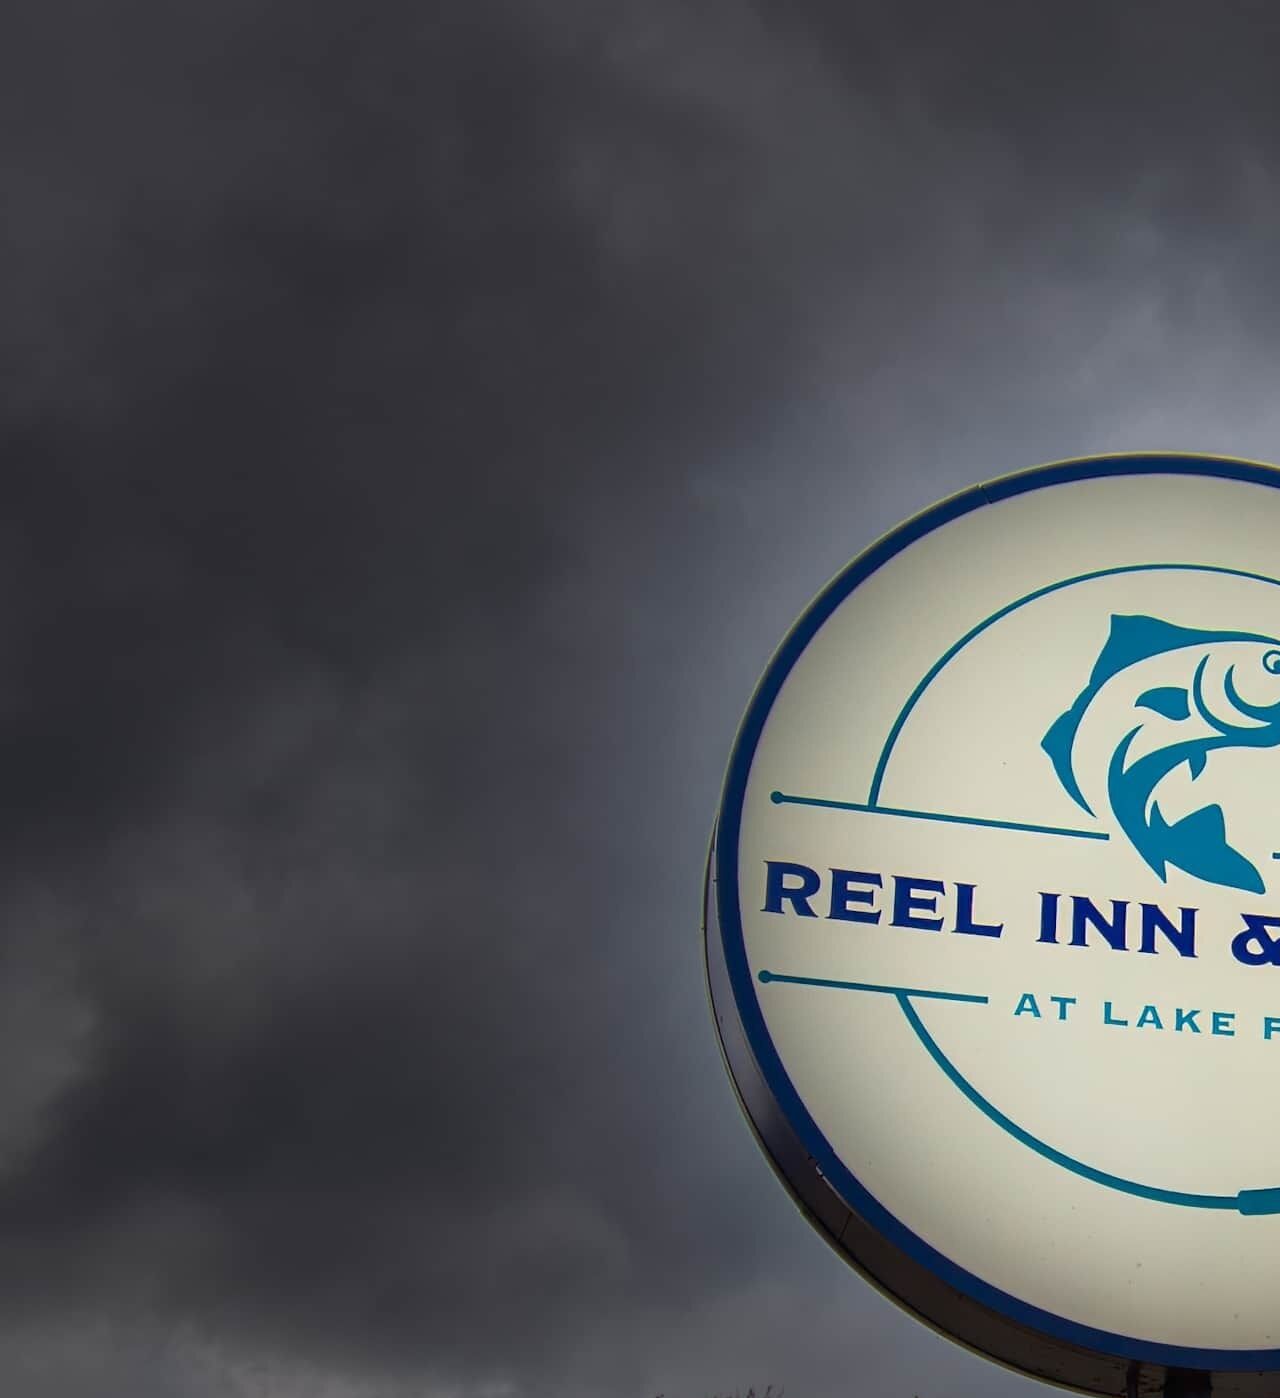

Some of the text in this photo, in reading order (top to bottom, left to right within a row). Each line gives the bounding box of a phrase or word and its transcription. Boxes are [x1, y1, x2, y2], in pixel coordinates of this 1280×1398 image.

[759, 859, 1004, 939] REEL
[1035, 891, 1199, 959] INN
[1013, 993, 1077, 1021] AT
[1103, 1001, 1236, 1037] LAKE
